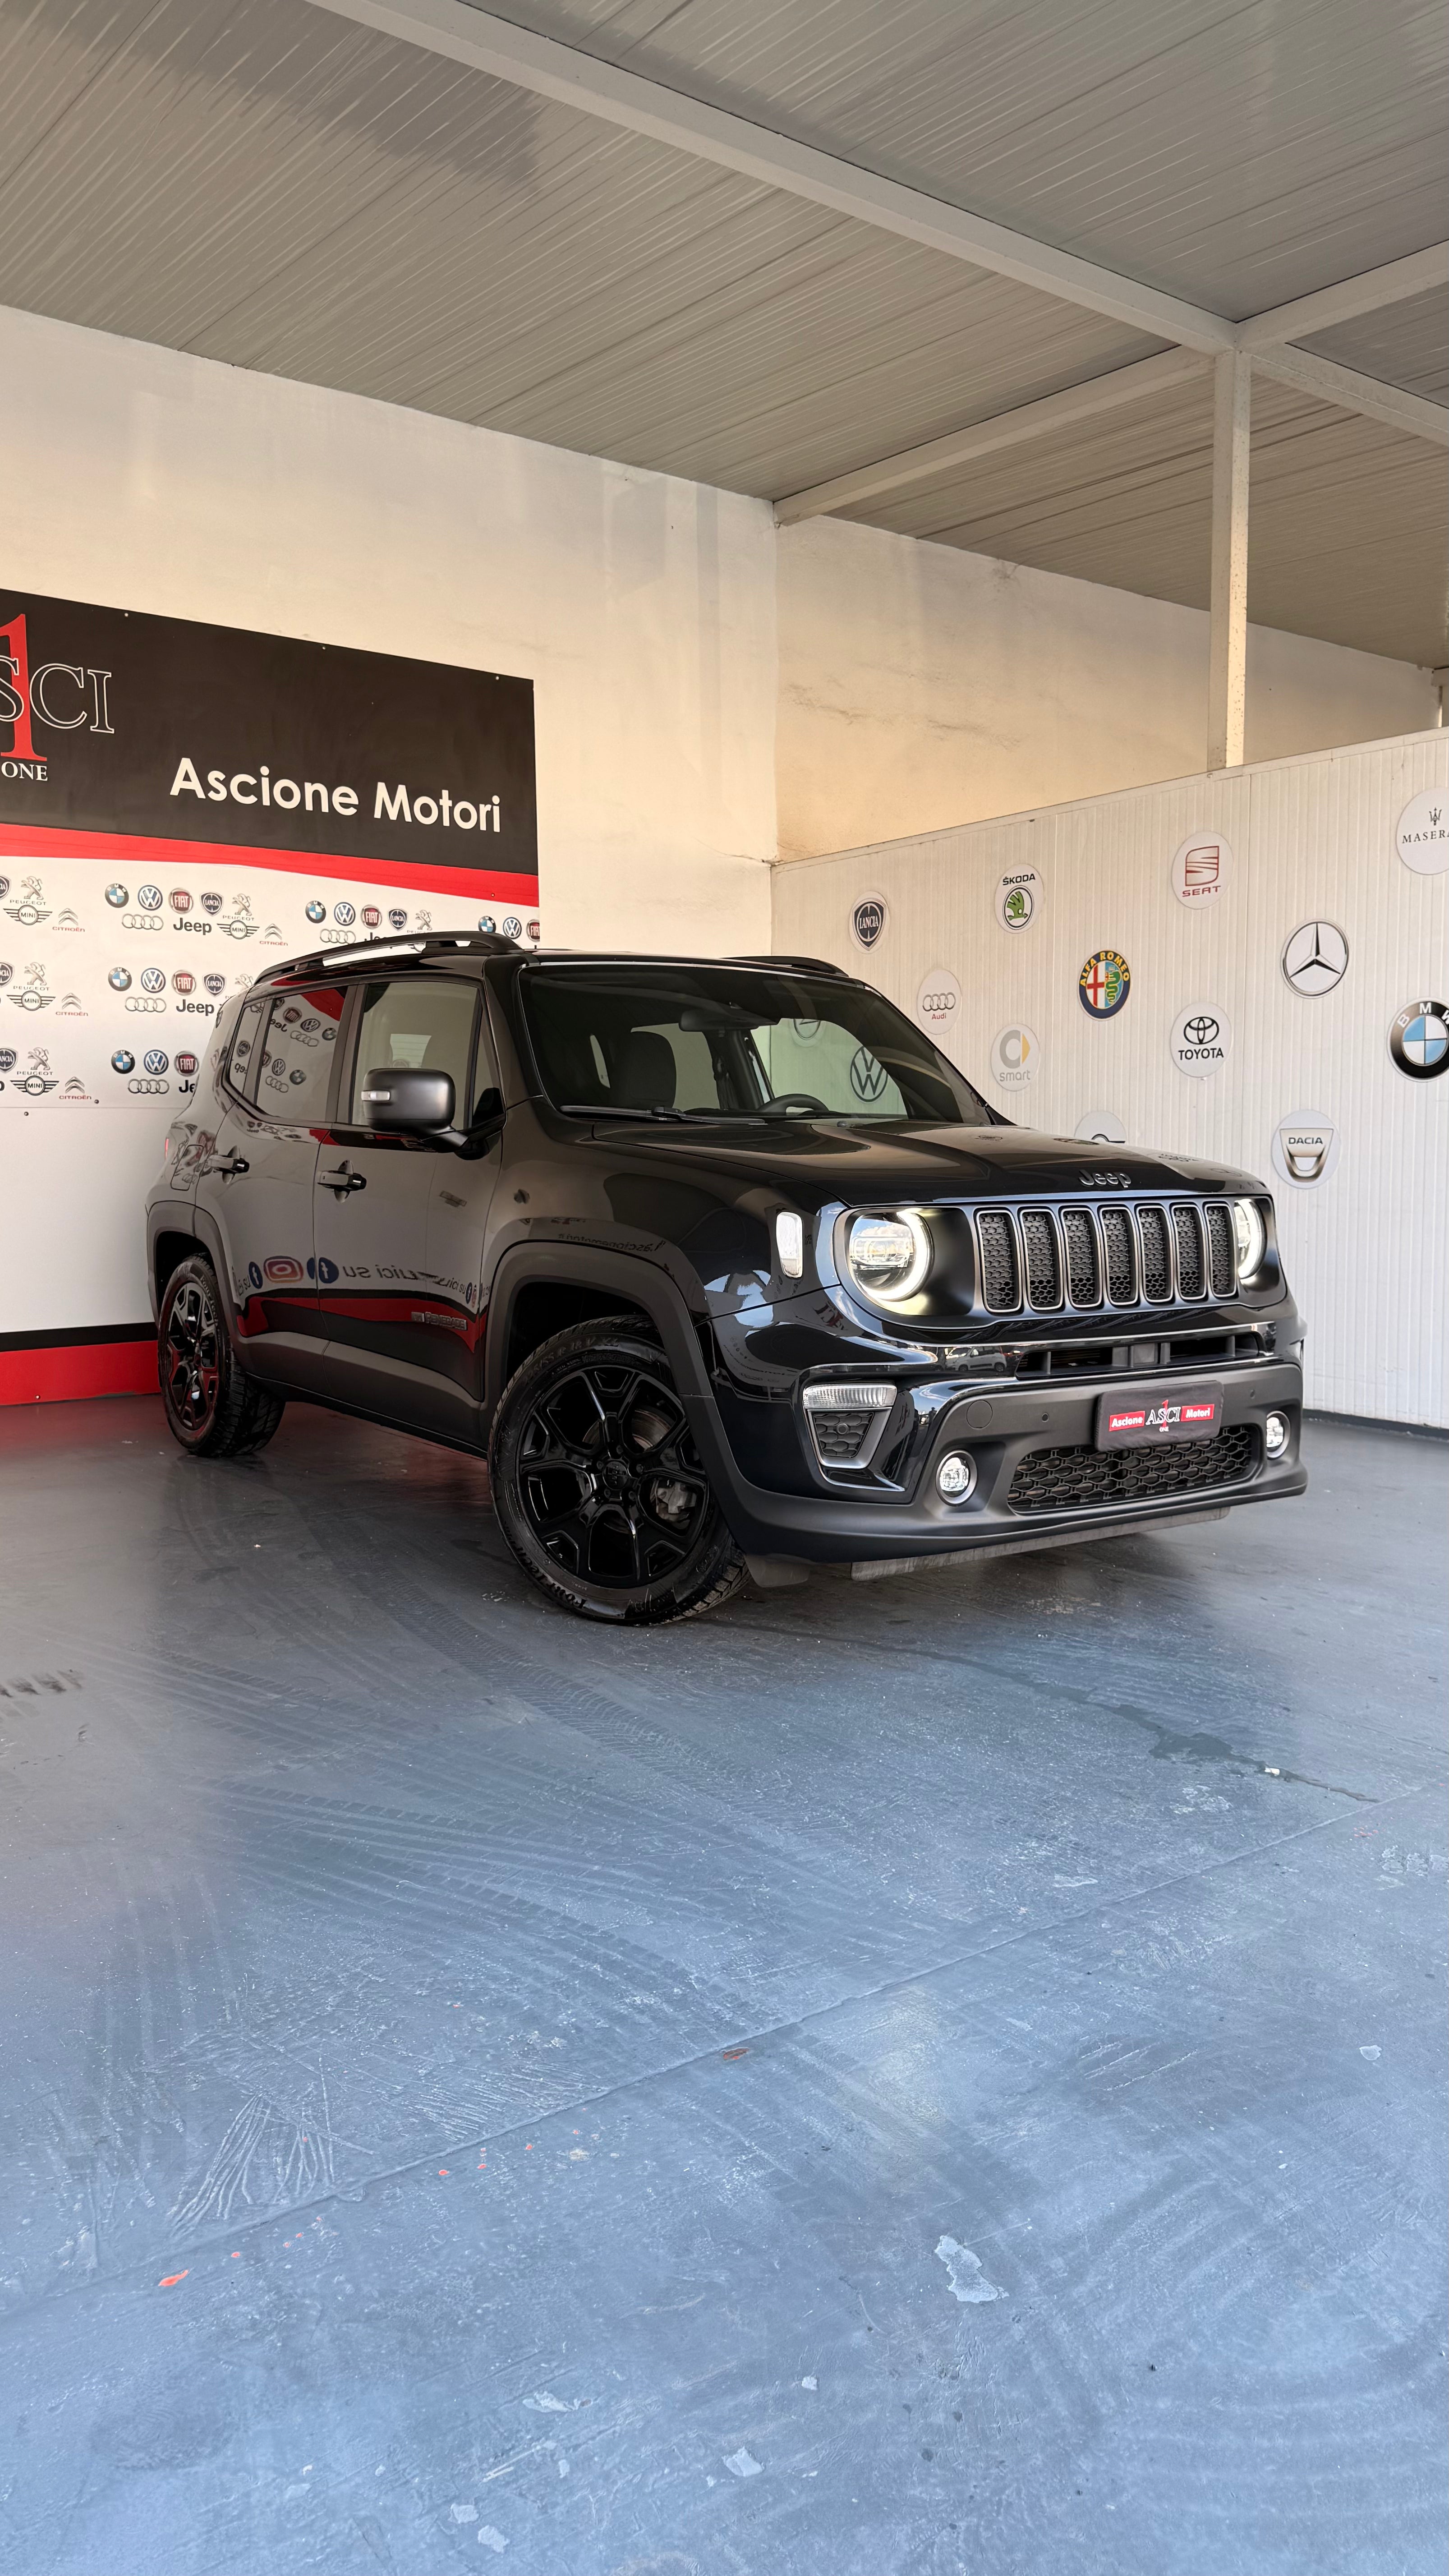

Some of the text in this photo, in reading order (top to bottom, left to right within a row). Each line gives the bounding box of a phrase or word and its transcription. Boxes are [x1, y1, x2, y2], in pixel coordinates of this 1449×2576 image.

[1, 761, 48, 781] ONE
[170, 757, 500, 833] Ascione Motori
[1002, 873, 1036, 886] ŠKODA
[1182, 885, 1221, 897] SEAT
[174, 895, 189, 908] FIAT
[365, 912, 378, 923] FIAT
[859, 915, 879, 929] LANCIA
[173, 917, 212, 935] Jeep
[1080, 952, 1129, 987] ALFA ROMEO
[177, 977, 192, 989] FIAT
[176, 999, 215, 1017] Jeep
[931, 1012, 947, 1021] Audi
[1178, 1047, 1224, 1061] TOYOTA
[180, 1058, 194, 1070] FIAT
[999, 1069, 1031, 1082] smart
[179, 1080, 195, 1093] Je
[1288, 1136, 1323, 1145] DACIA
[1078, 1169, 1132, 1188] Jeep
[1111, 1406, 1210, 1428] Ascione ASCI Motori
